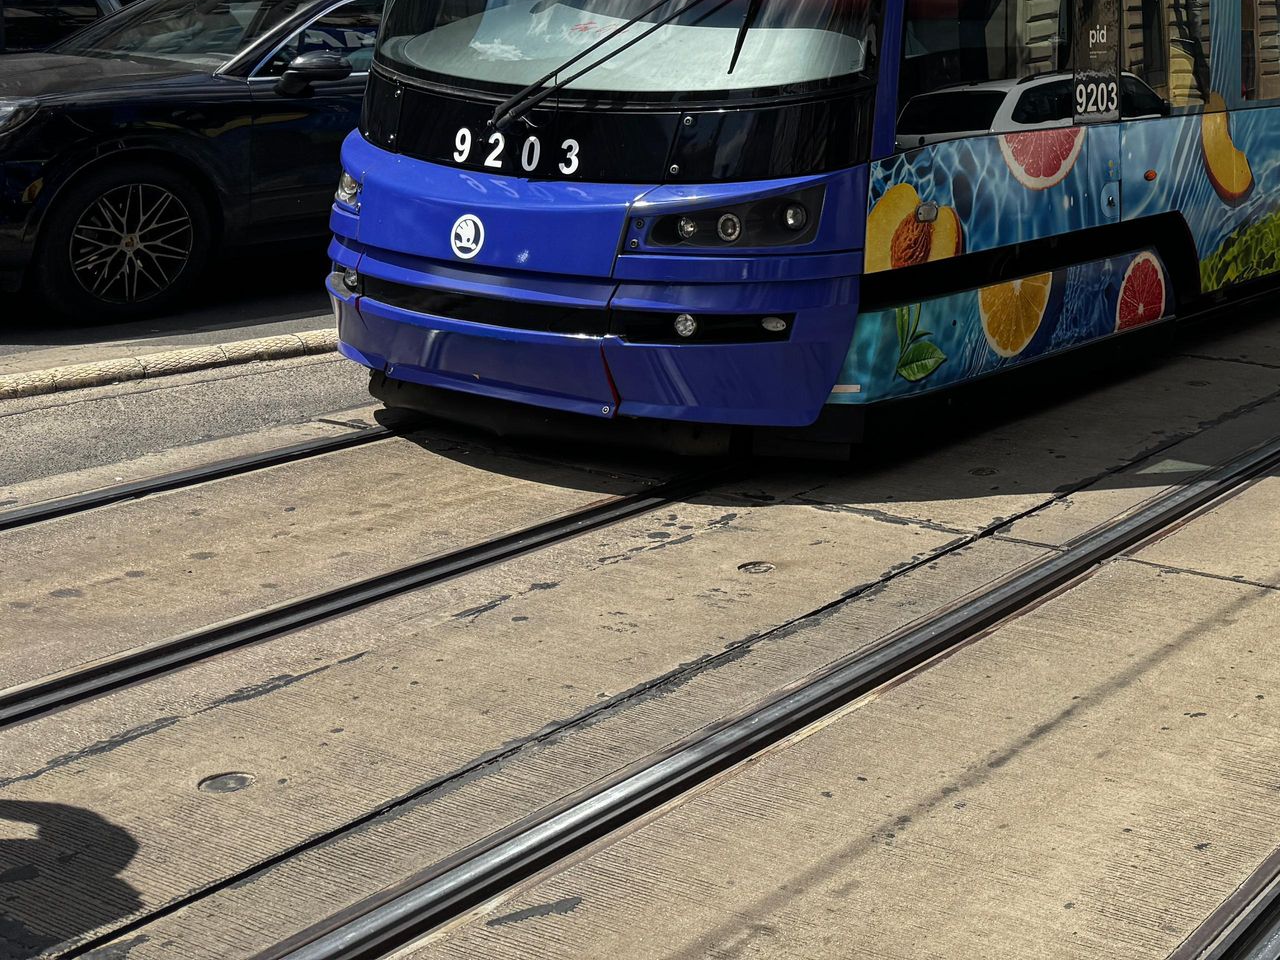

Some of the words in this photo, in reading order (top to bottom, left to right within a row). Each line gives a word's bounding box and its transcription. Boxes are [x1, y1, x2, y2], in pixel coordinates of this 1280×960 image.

[1089, 24, 1107, 48] pid
[1076, 82, 1118, 113] 9203
[453, 127, 580, 175] 9203
